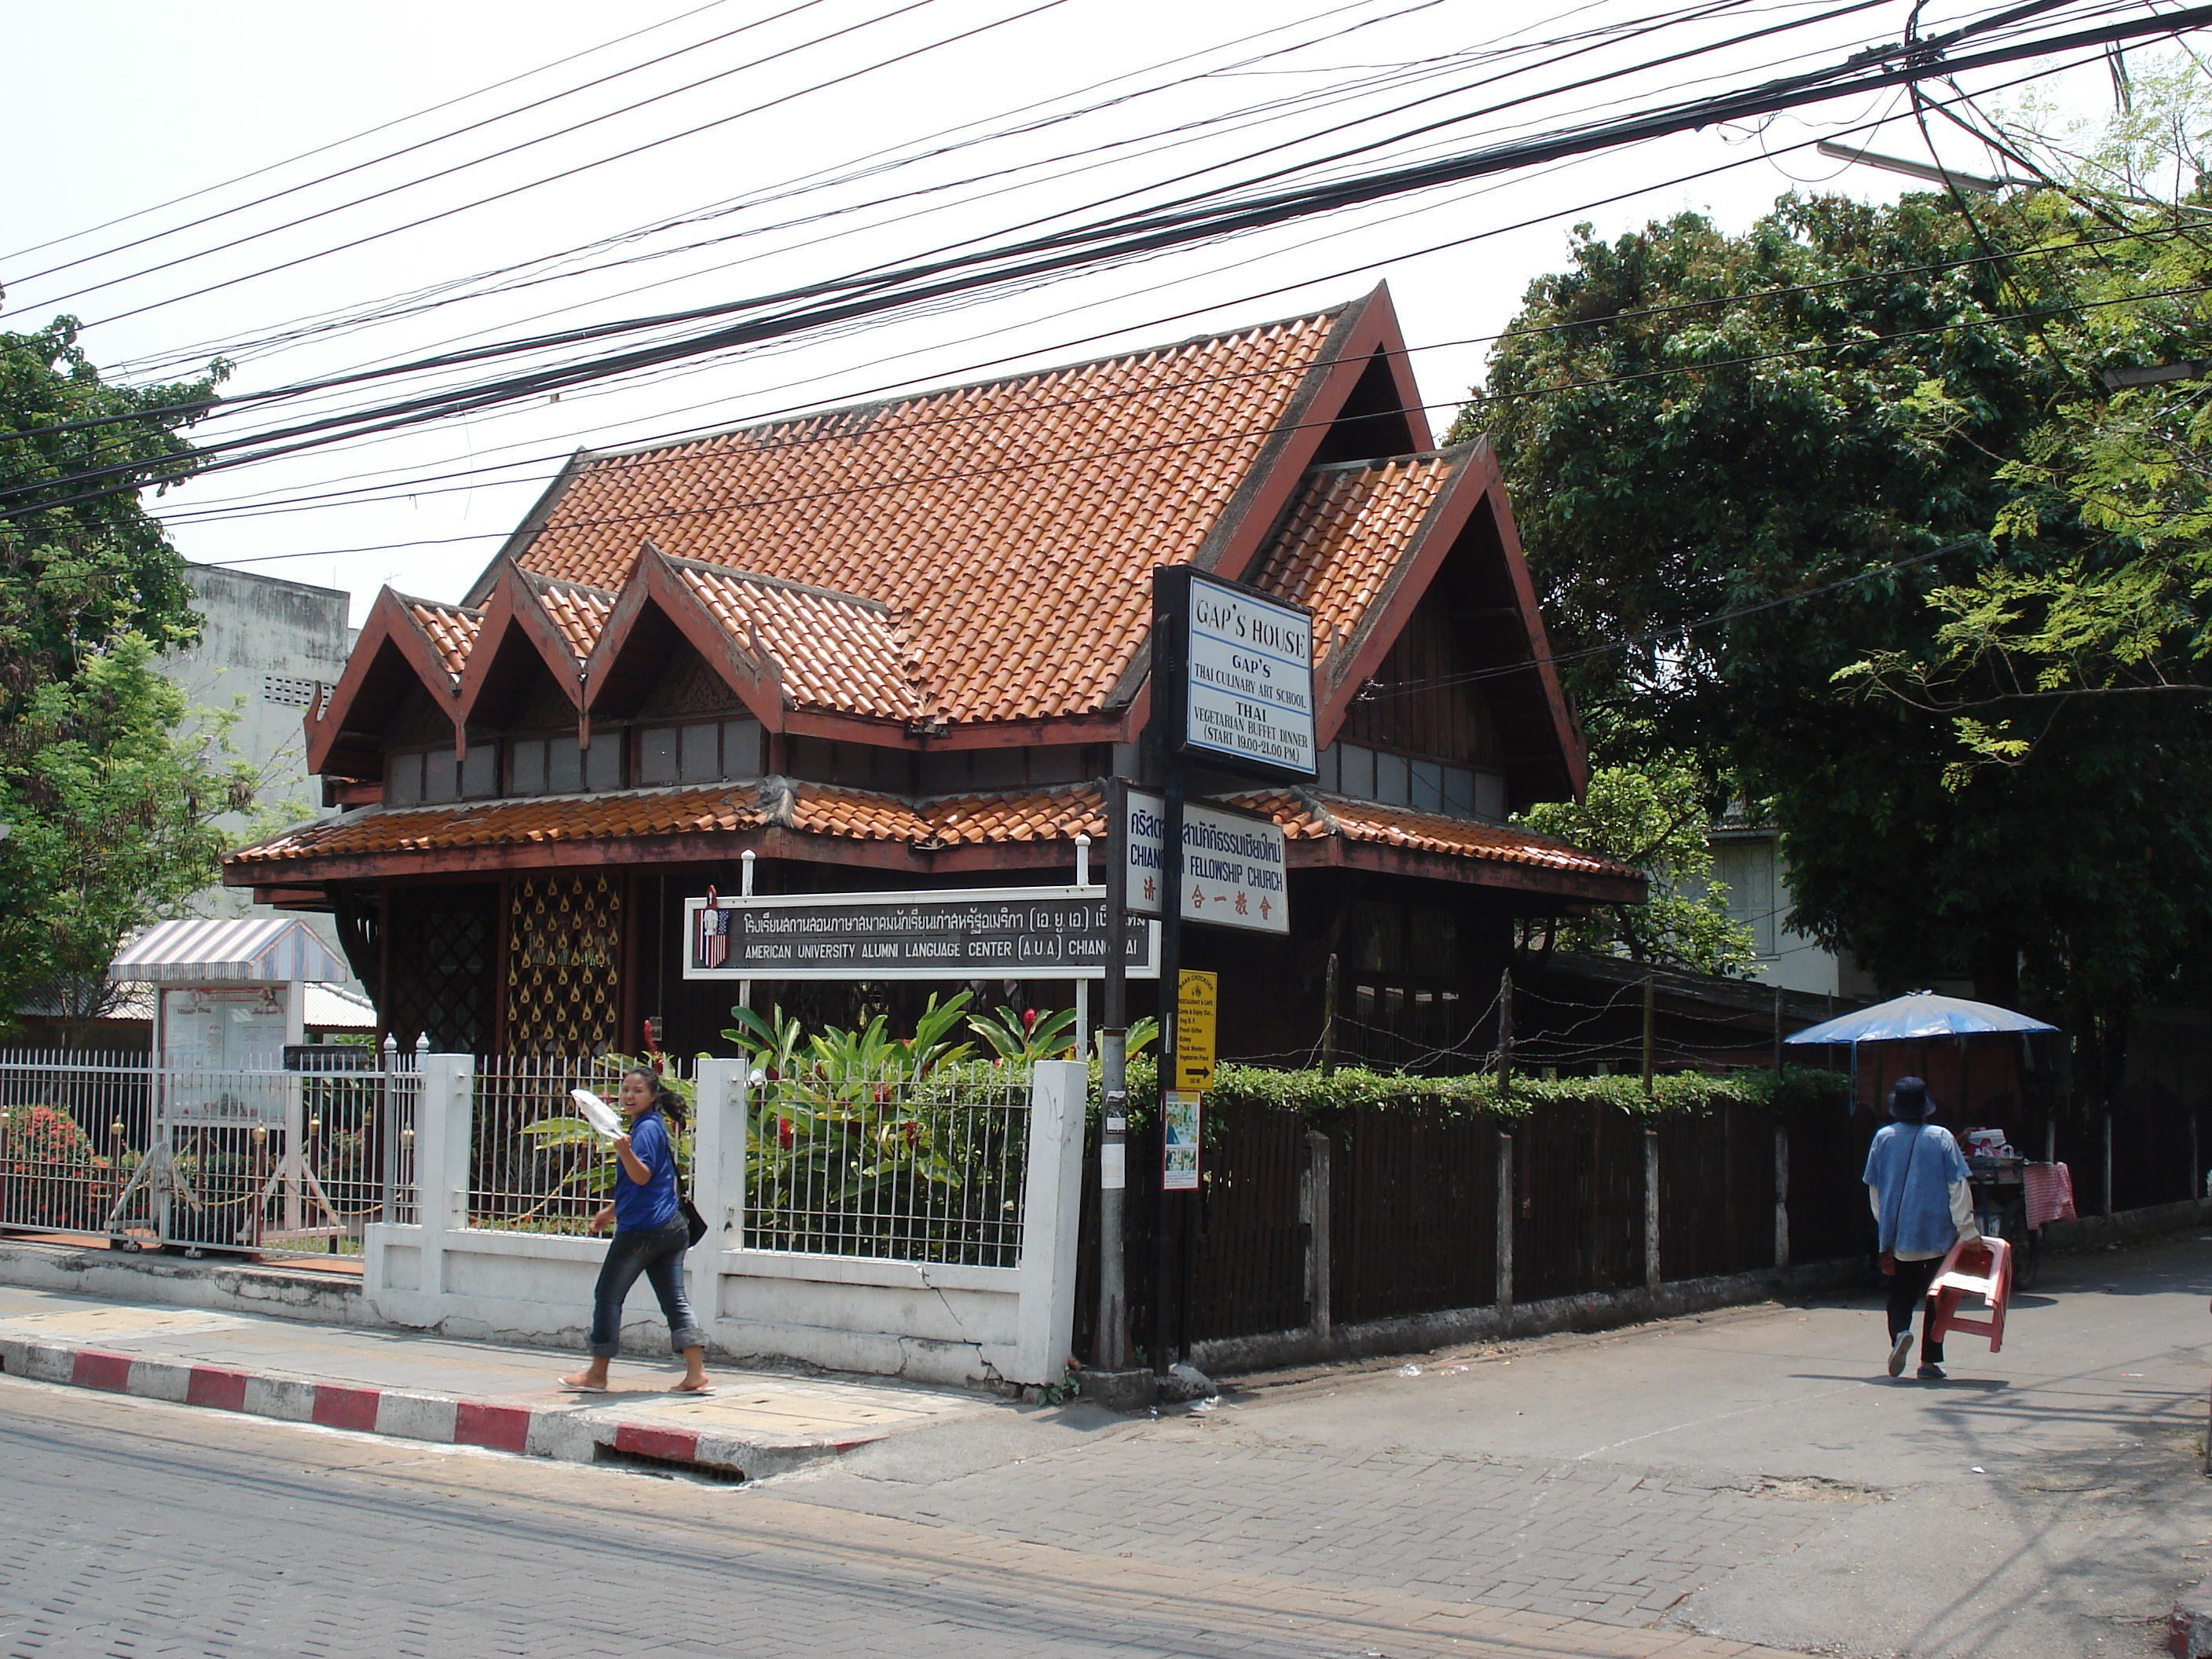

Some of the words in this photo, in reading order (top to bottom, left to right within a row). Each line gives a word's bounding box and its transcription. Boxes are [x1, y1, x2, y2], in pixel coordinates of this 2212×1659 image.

[1196, 599, 1247, 638] GAP'S
[1253, 618, 1306, 659] HOUSE
[1232, 654, 1272, 678] GAP'S
[1194, 663, 1214, 682] THAI
[1216, 669, 1256, 694] CULINARY
[1258, 682, 1273, 700] ART
[1276, 688, 1307, 709] SCHOOL
[1194, 705, 1244, 732] VEGETARIAN
[1247, 720, 1276, 741] BUFFET
[1280, 729, 1309, 749] DINNER
[1236, 701, 1267, 723] THAI
[1203, 724, 1232, 745] (START
[1190, 855, 1243, 884] FELLOWSHIP
[1247, 866, 1284, 892] CHURCH
[745, 945, 792, 959] AMERICAN
[798, 943, 855, 958] UNIVERSITY
[862, 943, 899, 958] ALUMNI
[905, 942, 961, 958] LANGUAGE
[968, 941, 1012, 957] CENTER
[1018, 934, 1062, 961] (A.U.A.)
